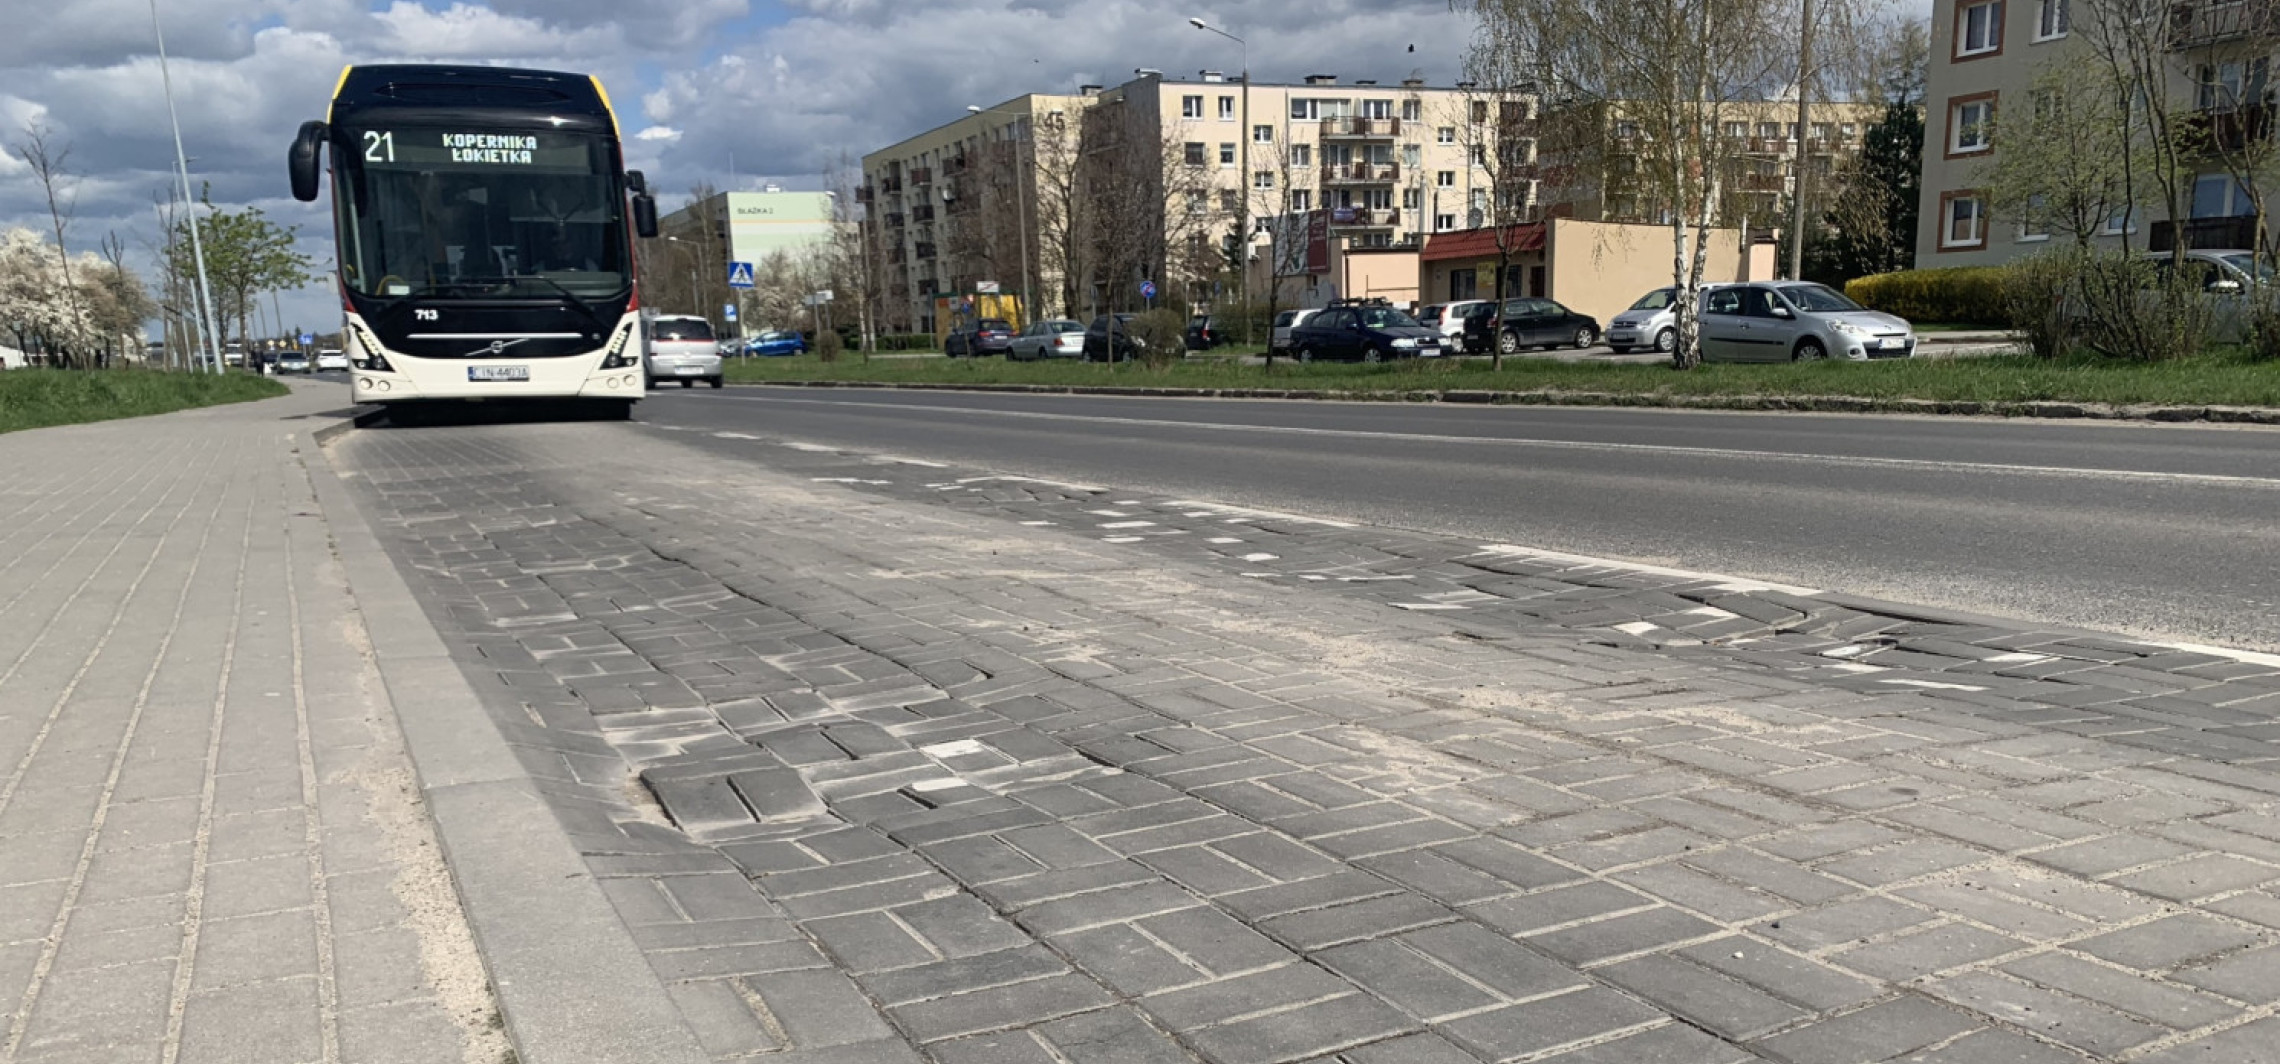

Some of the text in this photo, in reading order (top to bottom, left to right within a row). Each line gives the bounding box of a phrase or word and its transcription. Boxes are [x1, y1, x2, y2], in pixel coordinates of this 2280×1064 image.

[363, 130, 395, 163] 21
[442, 133, 538, 150] KOPERNIKA
[452, 148, 532, 164] ŁOKIETKA
[414, 309, 439, 320] 713
